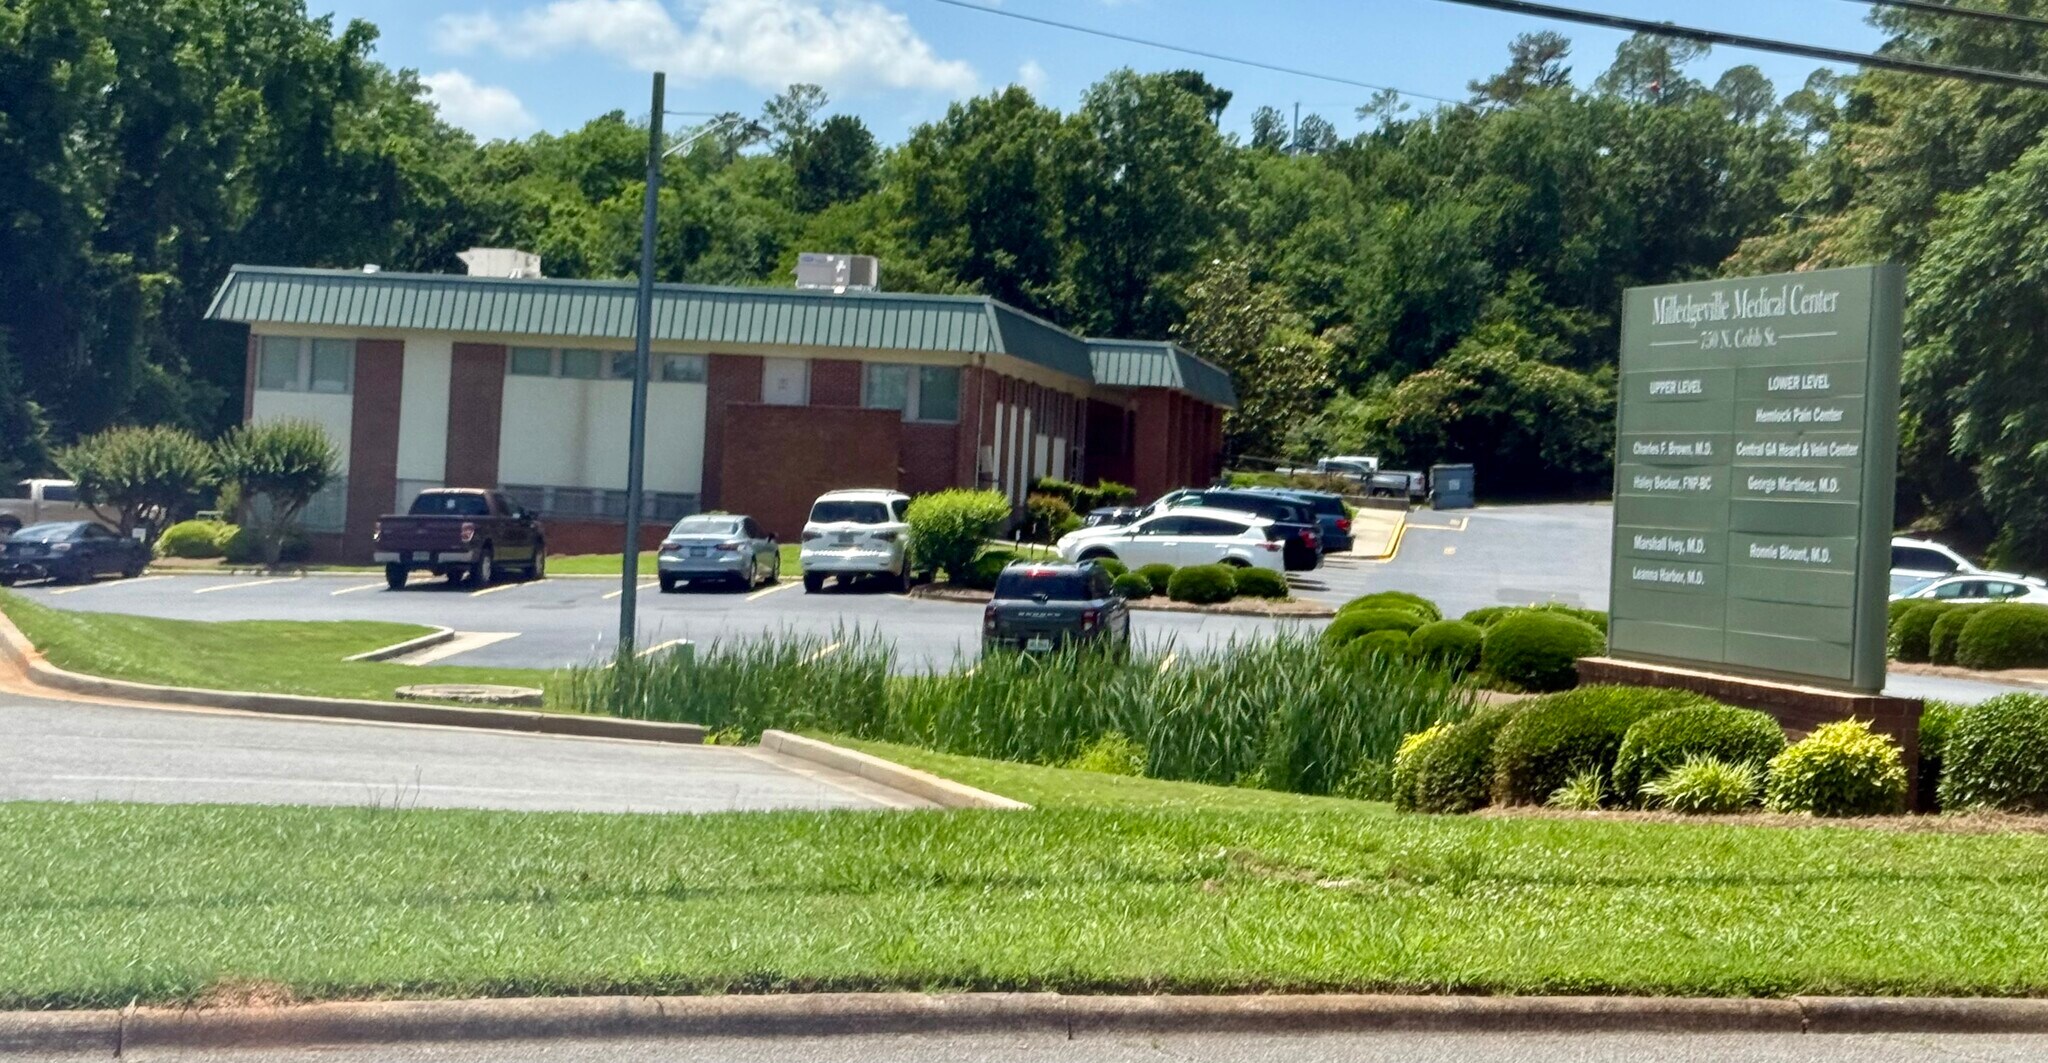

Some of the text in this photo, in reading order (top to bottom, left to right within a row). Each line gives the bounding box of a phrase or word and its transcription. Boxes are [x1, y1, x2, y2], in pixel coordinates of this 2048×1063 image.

[1652, 284, 1839, 328] Milledgeville Medical Center
[1700, 330, 1718, 349] 750
[1720, 330, 1732, 348] N.
[1735, 327, 1762, 348] Cobb
[1650, 380, 1702, 394] UPPER LEVEL
[1768, 374, 1830, 391] LOWER LEVEL
[1755, 407, 1843, 422] Hemlock Pain Center
[1633, 441, 1659, 455] Charles
[1660, 441, 1667, 455] F.
[1695, 441, 1712, 455] M.D.
[1736, 441, 1858, 457] Central GA Heart & Vein Center
[1634, 476, 1711, 492] Haley Becker, FNP-BC
[1748, 475, 1839, 494] George Martinez, M.D.
[1634, 535, 1706, 555] Marshall Ivey, M.D.
[1750, 543, 1832, 564] Ronnie Blount, M.D.
[1633, 566, 1704, 586] Leanna Harbor, M.D.
